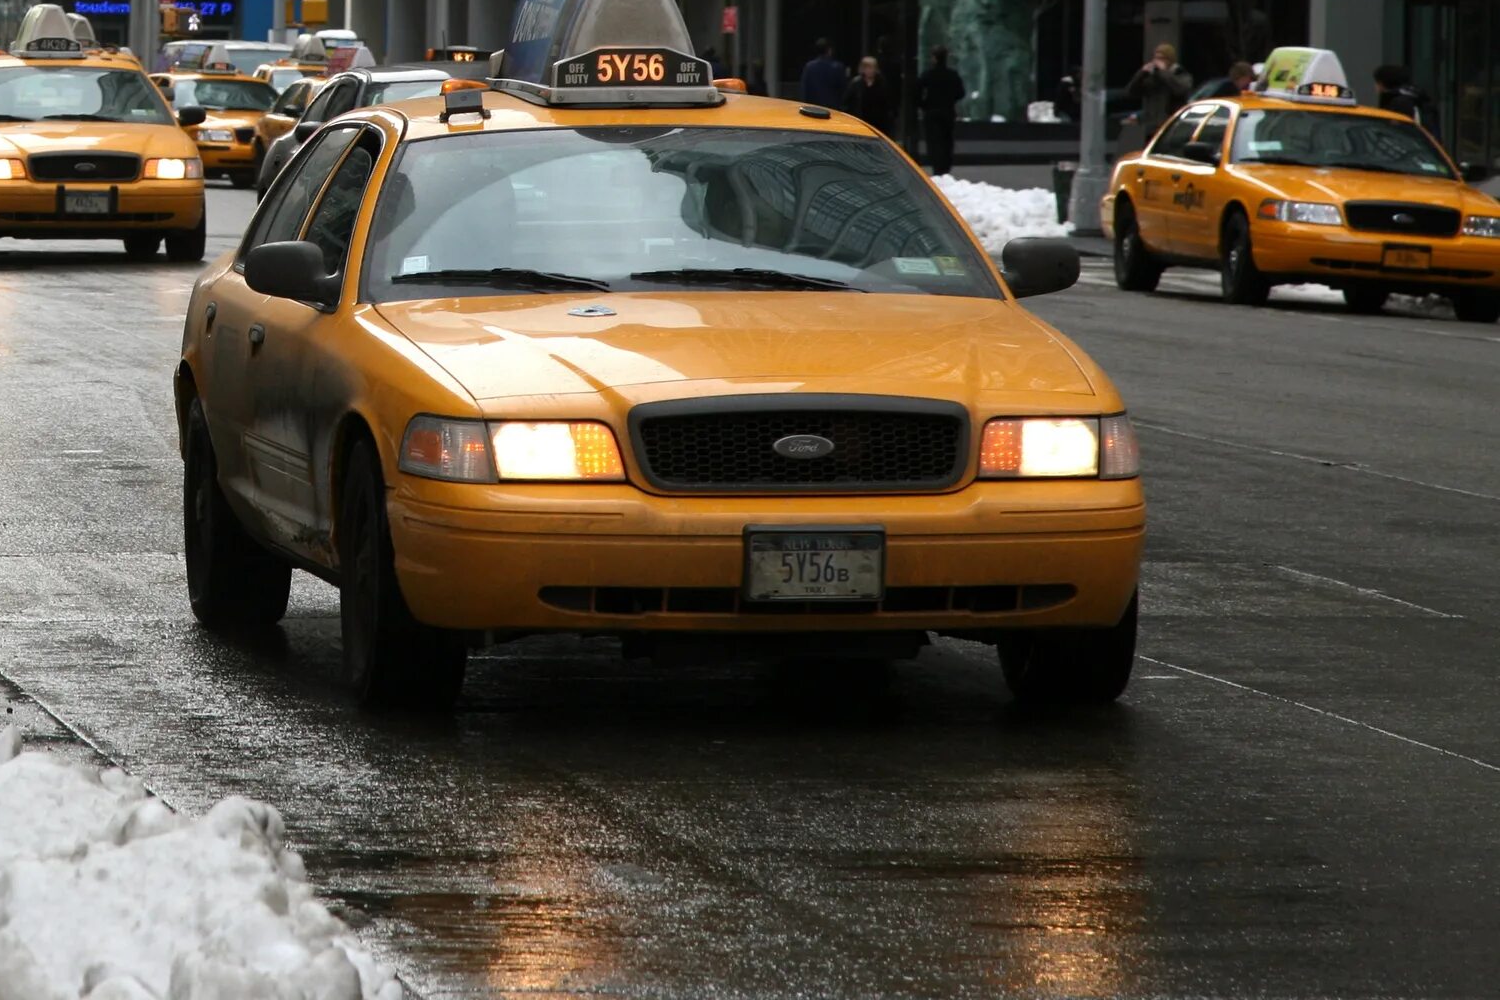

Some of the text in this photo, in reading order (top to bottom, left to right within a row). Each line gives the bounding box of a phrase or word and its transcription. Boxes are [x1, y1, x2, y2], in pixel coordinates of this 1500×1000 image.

[569, 53, 696, 82] OFF 5Y56 OFF
[565, 73, 701, 84] DUTY DUTY
[788, 439, 820, 453] Ford
